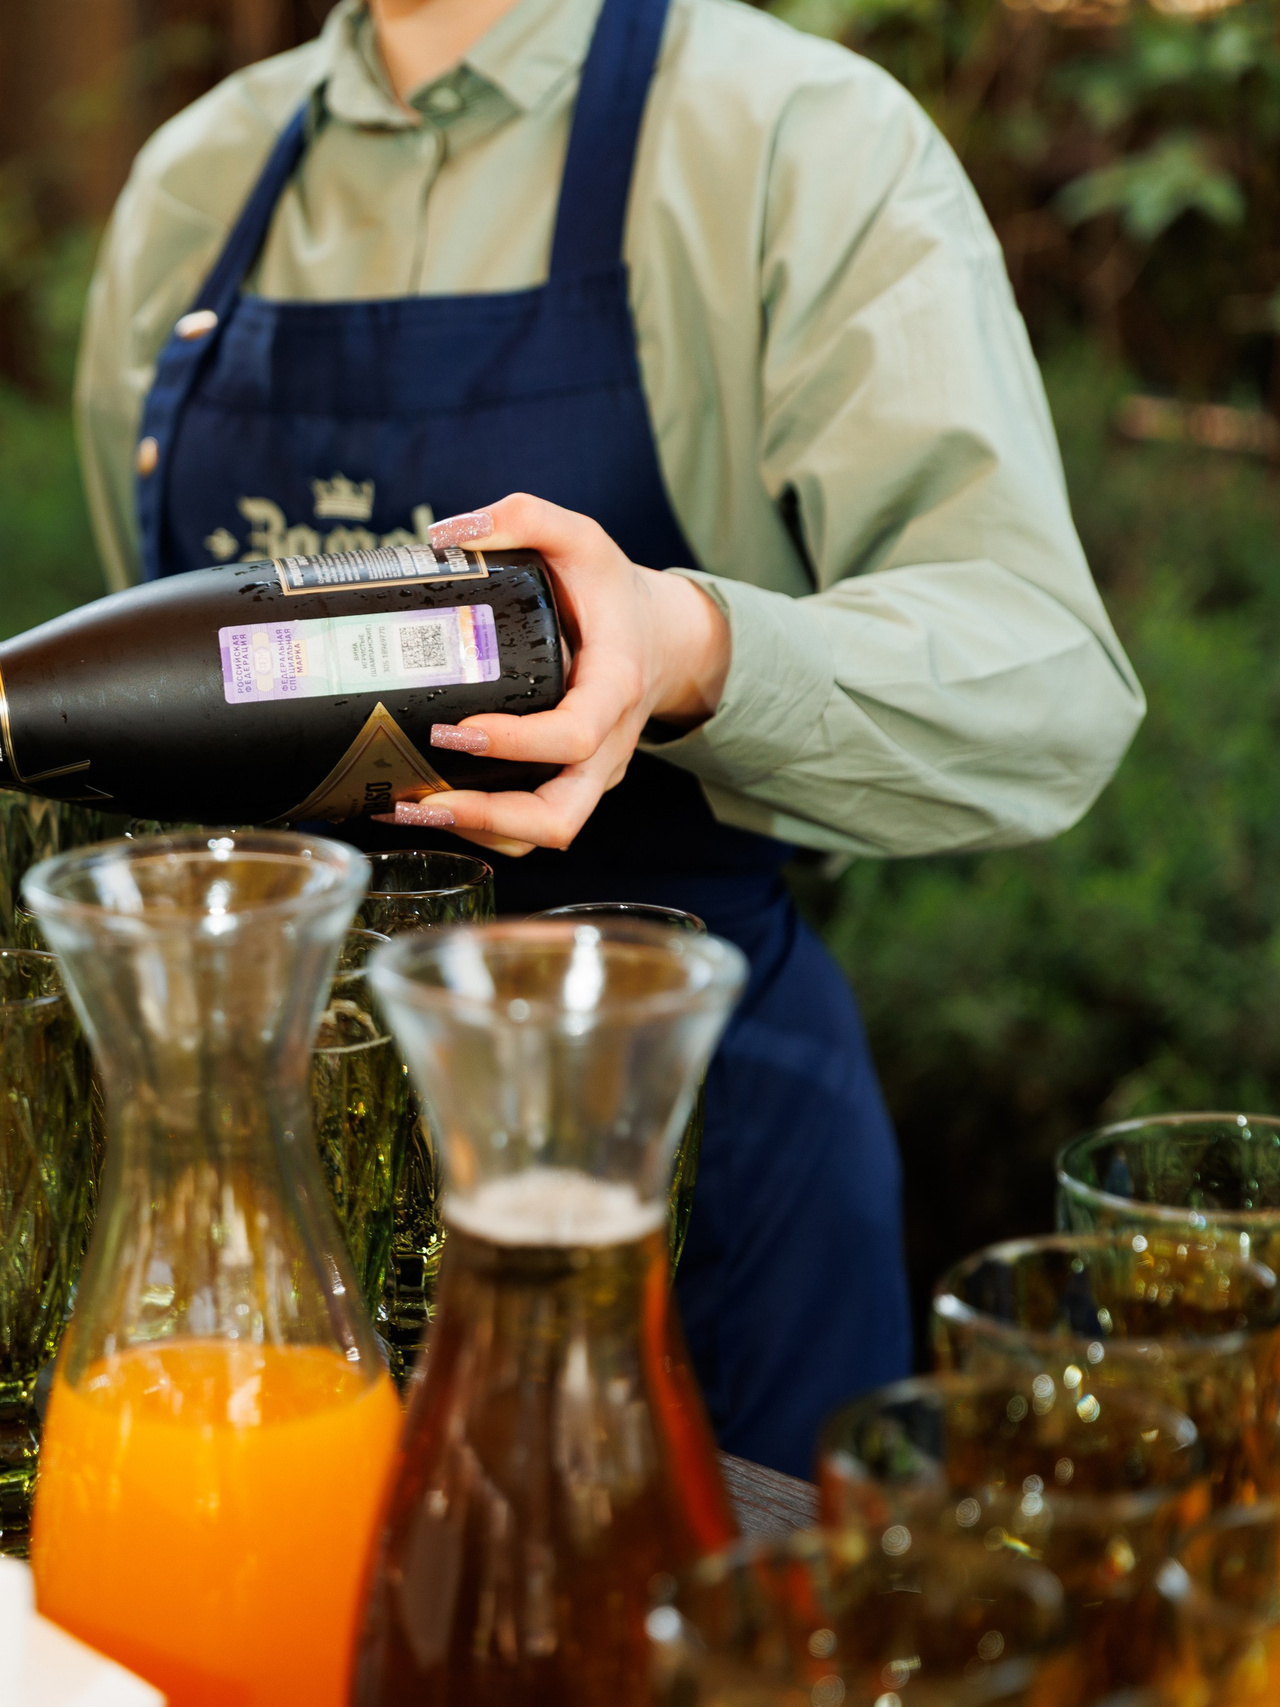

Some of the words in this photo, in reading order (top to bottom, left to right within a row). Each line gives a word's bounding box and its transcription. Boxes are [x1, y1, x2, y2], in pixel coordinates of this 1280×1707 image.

[232, 634, 244, 693] РОССИЙСКАЯ
[240, 633, 252, 693] ФЕДЕРАЦИЯ
[276, 629, 288, 691] ФЕДЕРАЛЬНАЯ
[284, 628, 297, 691] СПЕЦИАЛЬНАЯ
[294, 643, 303, 673] МАРКА
[359, 633, 368, 669] ИГРИСТЫЕ
